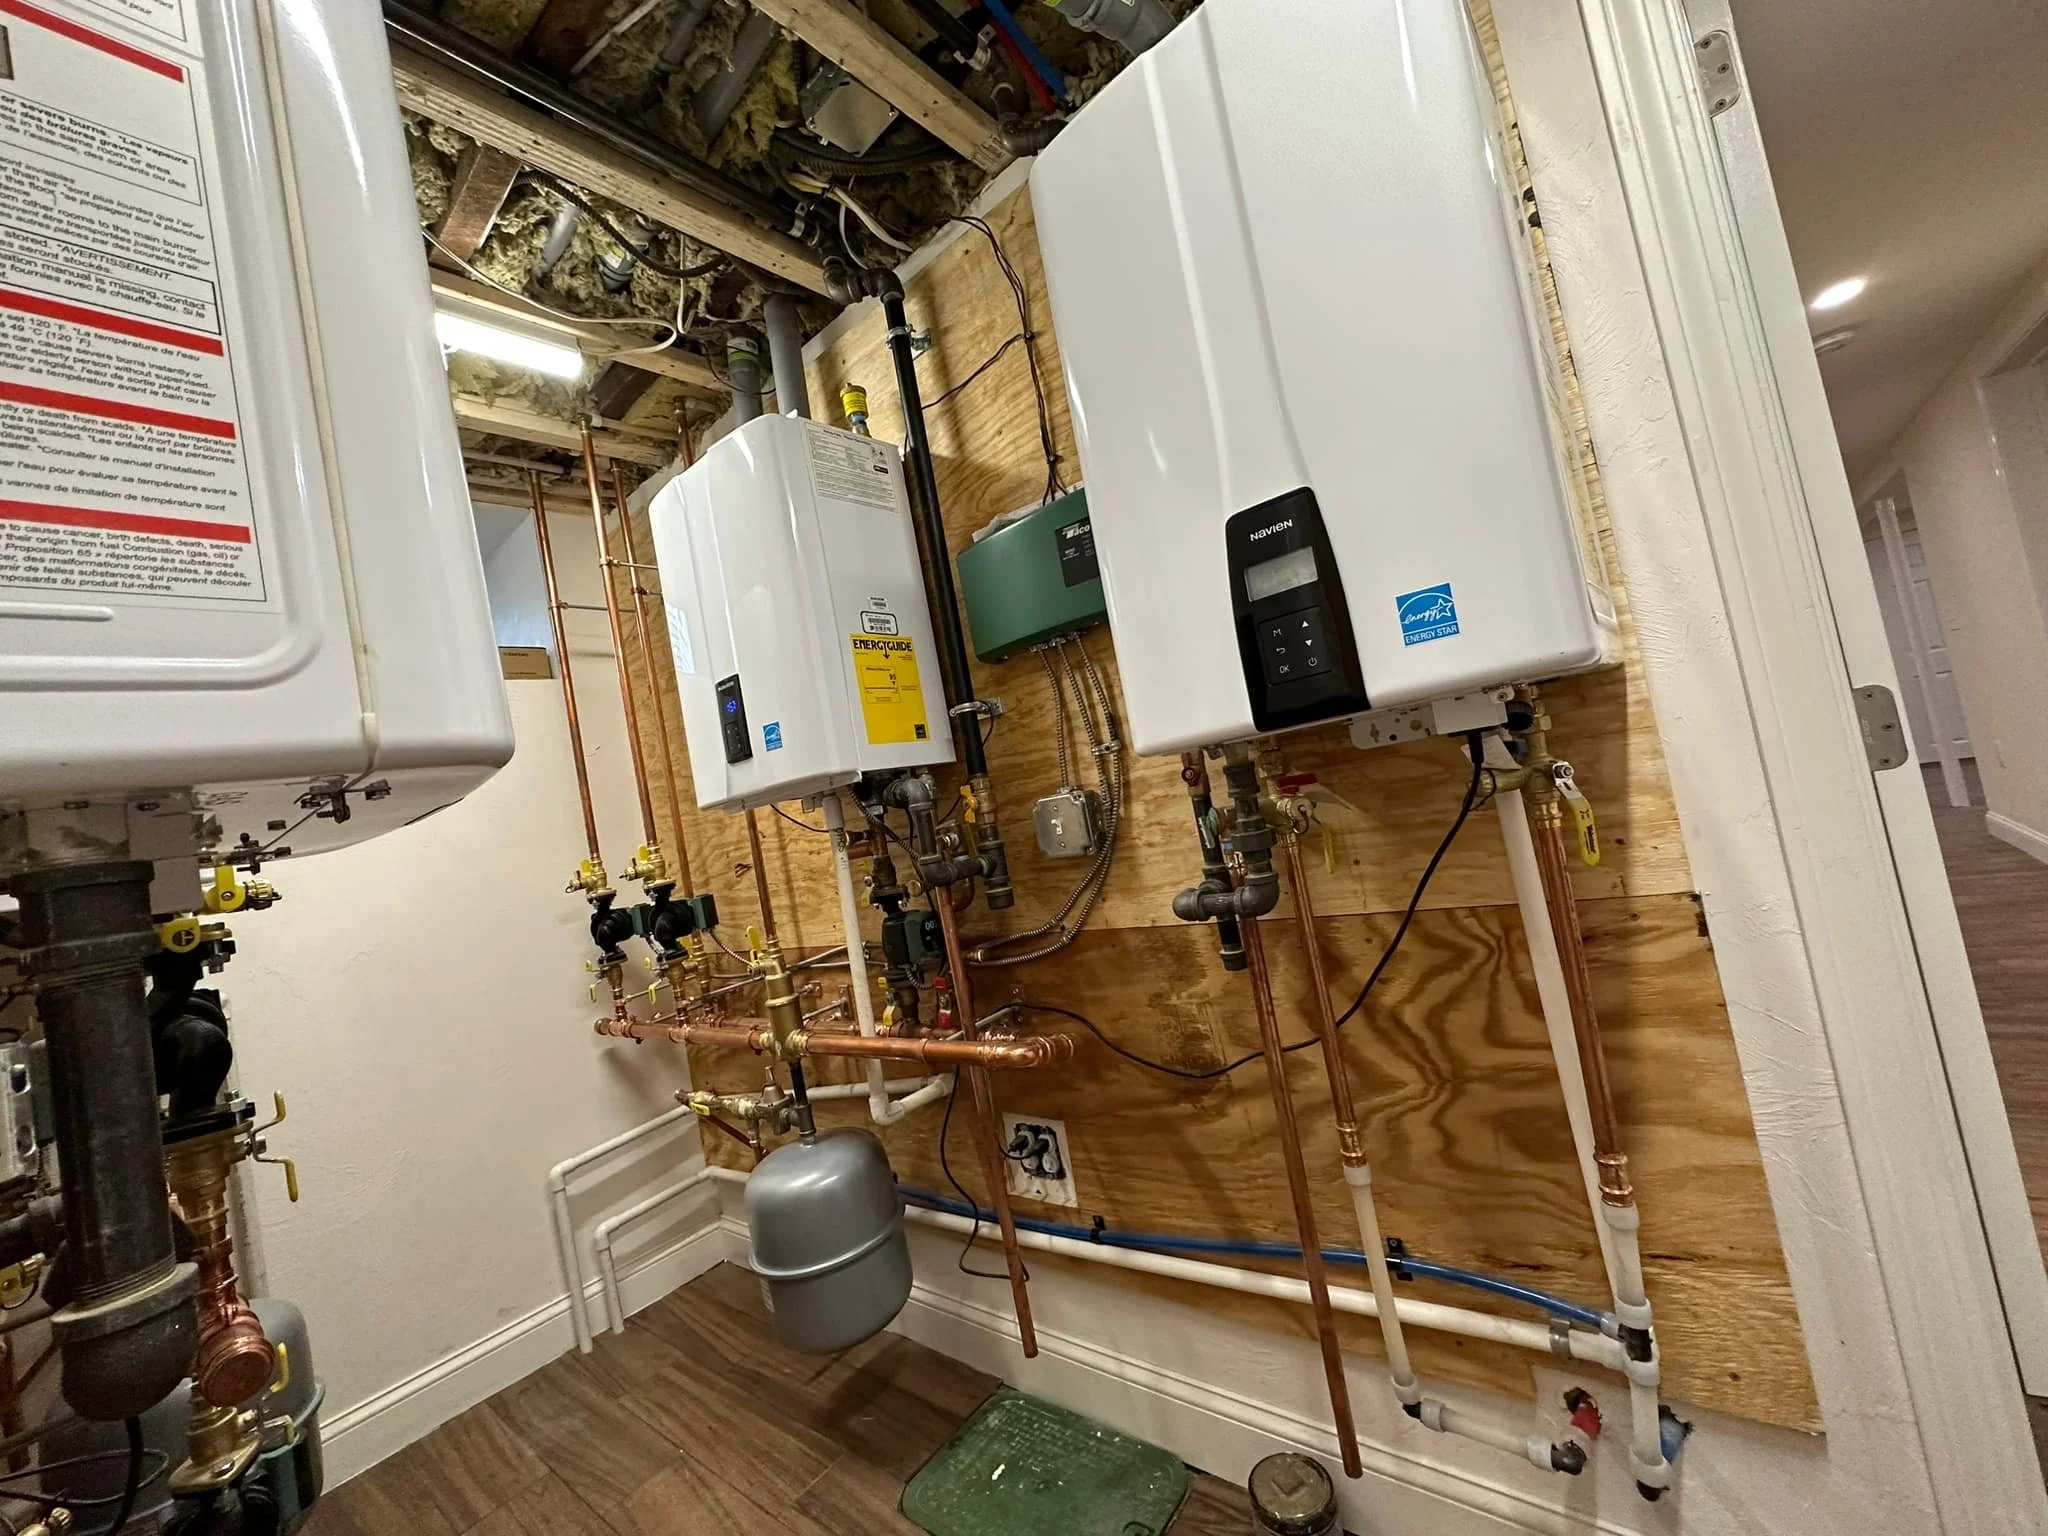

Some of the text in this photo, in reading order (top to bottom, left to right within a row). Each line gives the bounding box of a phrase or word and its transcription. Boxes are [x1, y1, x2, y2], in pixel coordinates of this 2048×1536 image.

[1272, 628, 1282, 637] M
[1405, 624, 1458, 644] ENERGY STAR
[1279, 664, 1291, 674] OK
